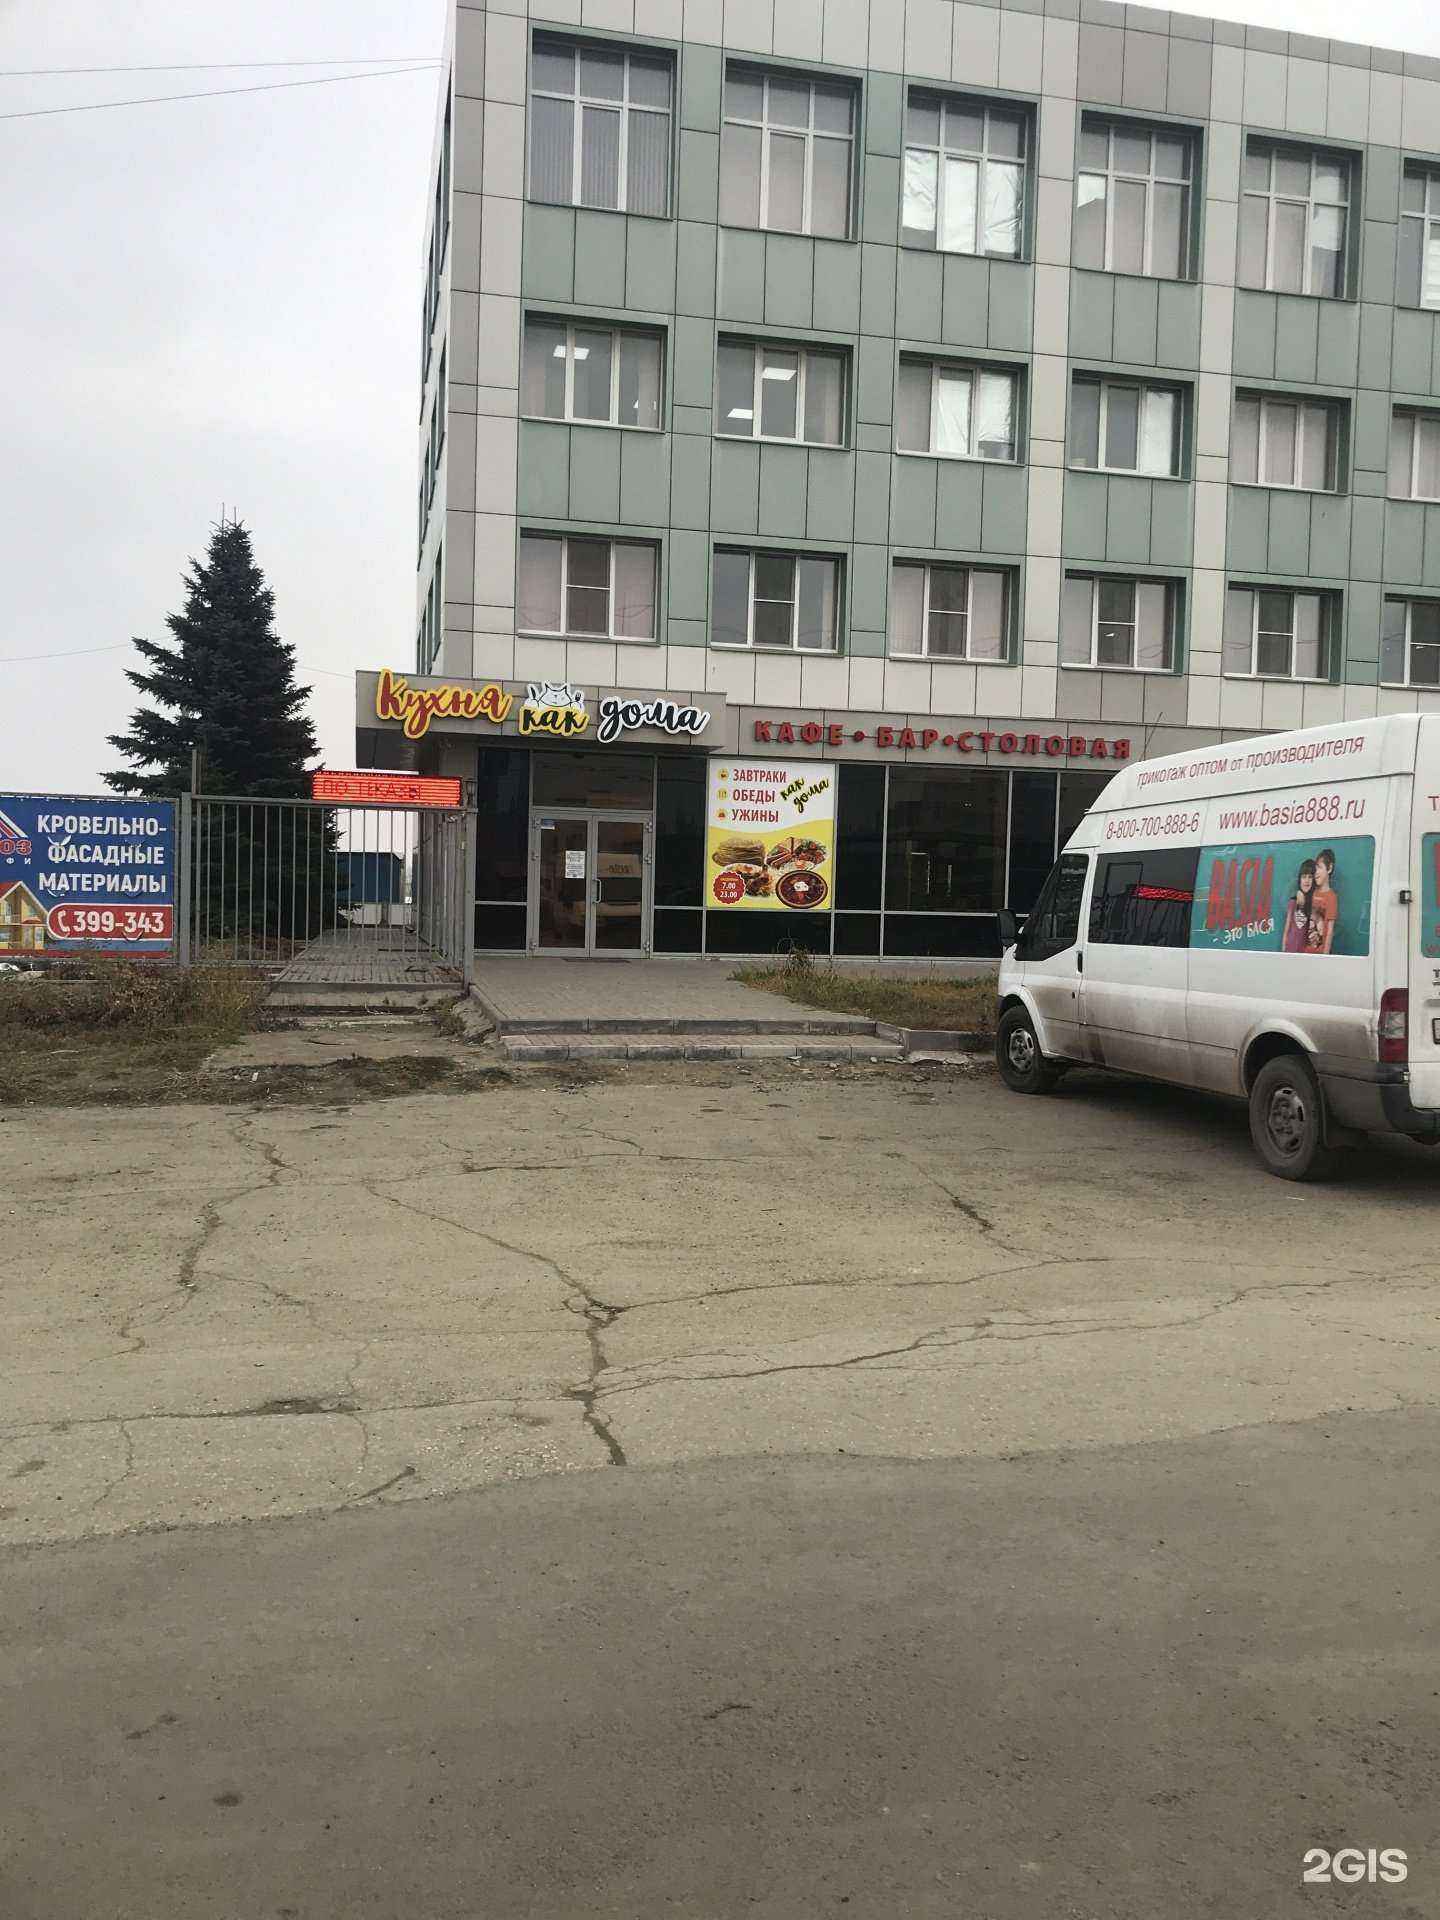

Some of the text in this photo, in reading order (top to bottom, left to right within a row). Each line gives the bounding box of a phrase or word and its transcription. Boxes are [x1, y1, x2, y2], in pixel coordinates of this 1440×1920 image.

[377, 669, 712, 743] Кухня как дома
[754, 720, 1132, 759] КАФЕ БАР СТОЛОВАЯ
[1135, 736, 1365, 789] трикотаж оптом от производителя
[732, 769, 787, 783] ЗАВТРАКИ
[732, 789, 776, 804] ОБЕДЫ
[731, 809, 779, 822] УЖИНЫ
[1219, 795, 1366, 830] www.basia888.ru
[37, 814, 167, 836] КРОВЕЛЬНО-
[1106, 812, 1200, 840] 8-800-700-888-6
[48, 844, 165, 866] ФАСАДНЫЕ
[39, 873, 166, 893] МАТЕРИАЛЫ
[73, 911, 165, 933] 399-343
